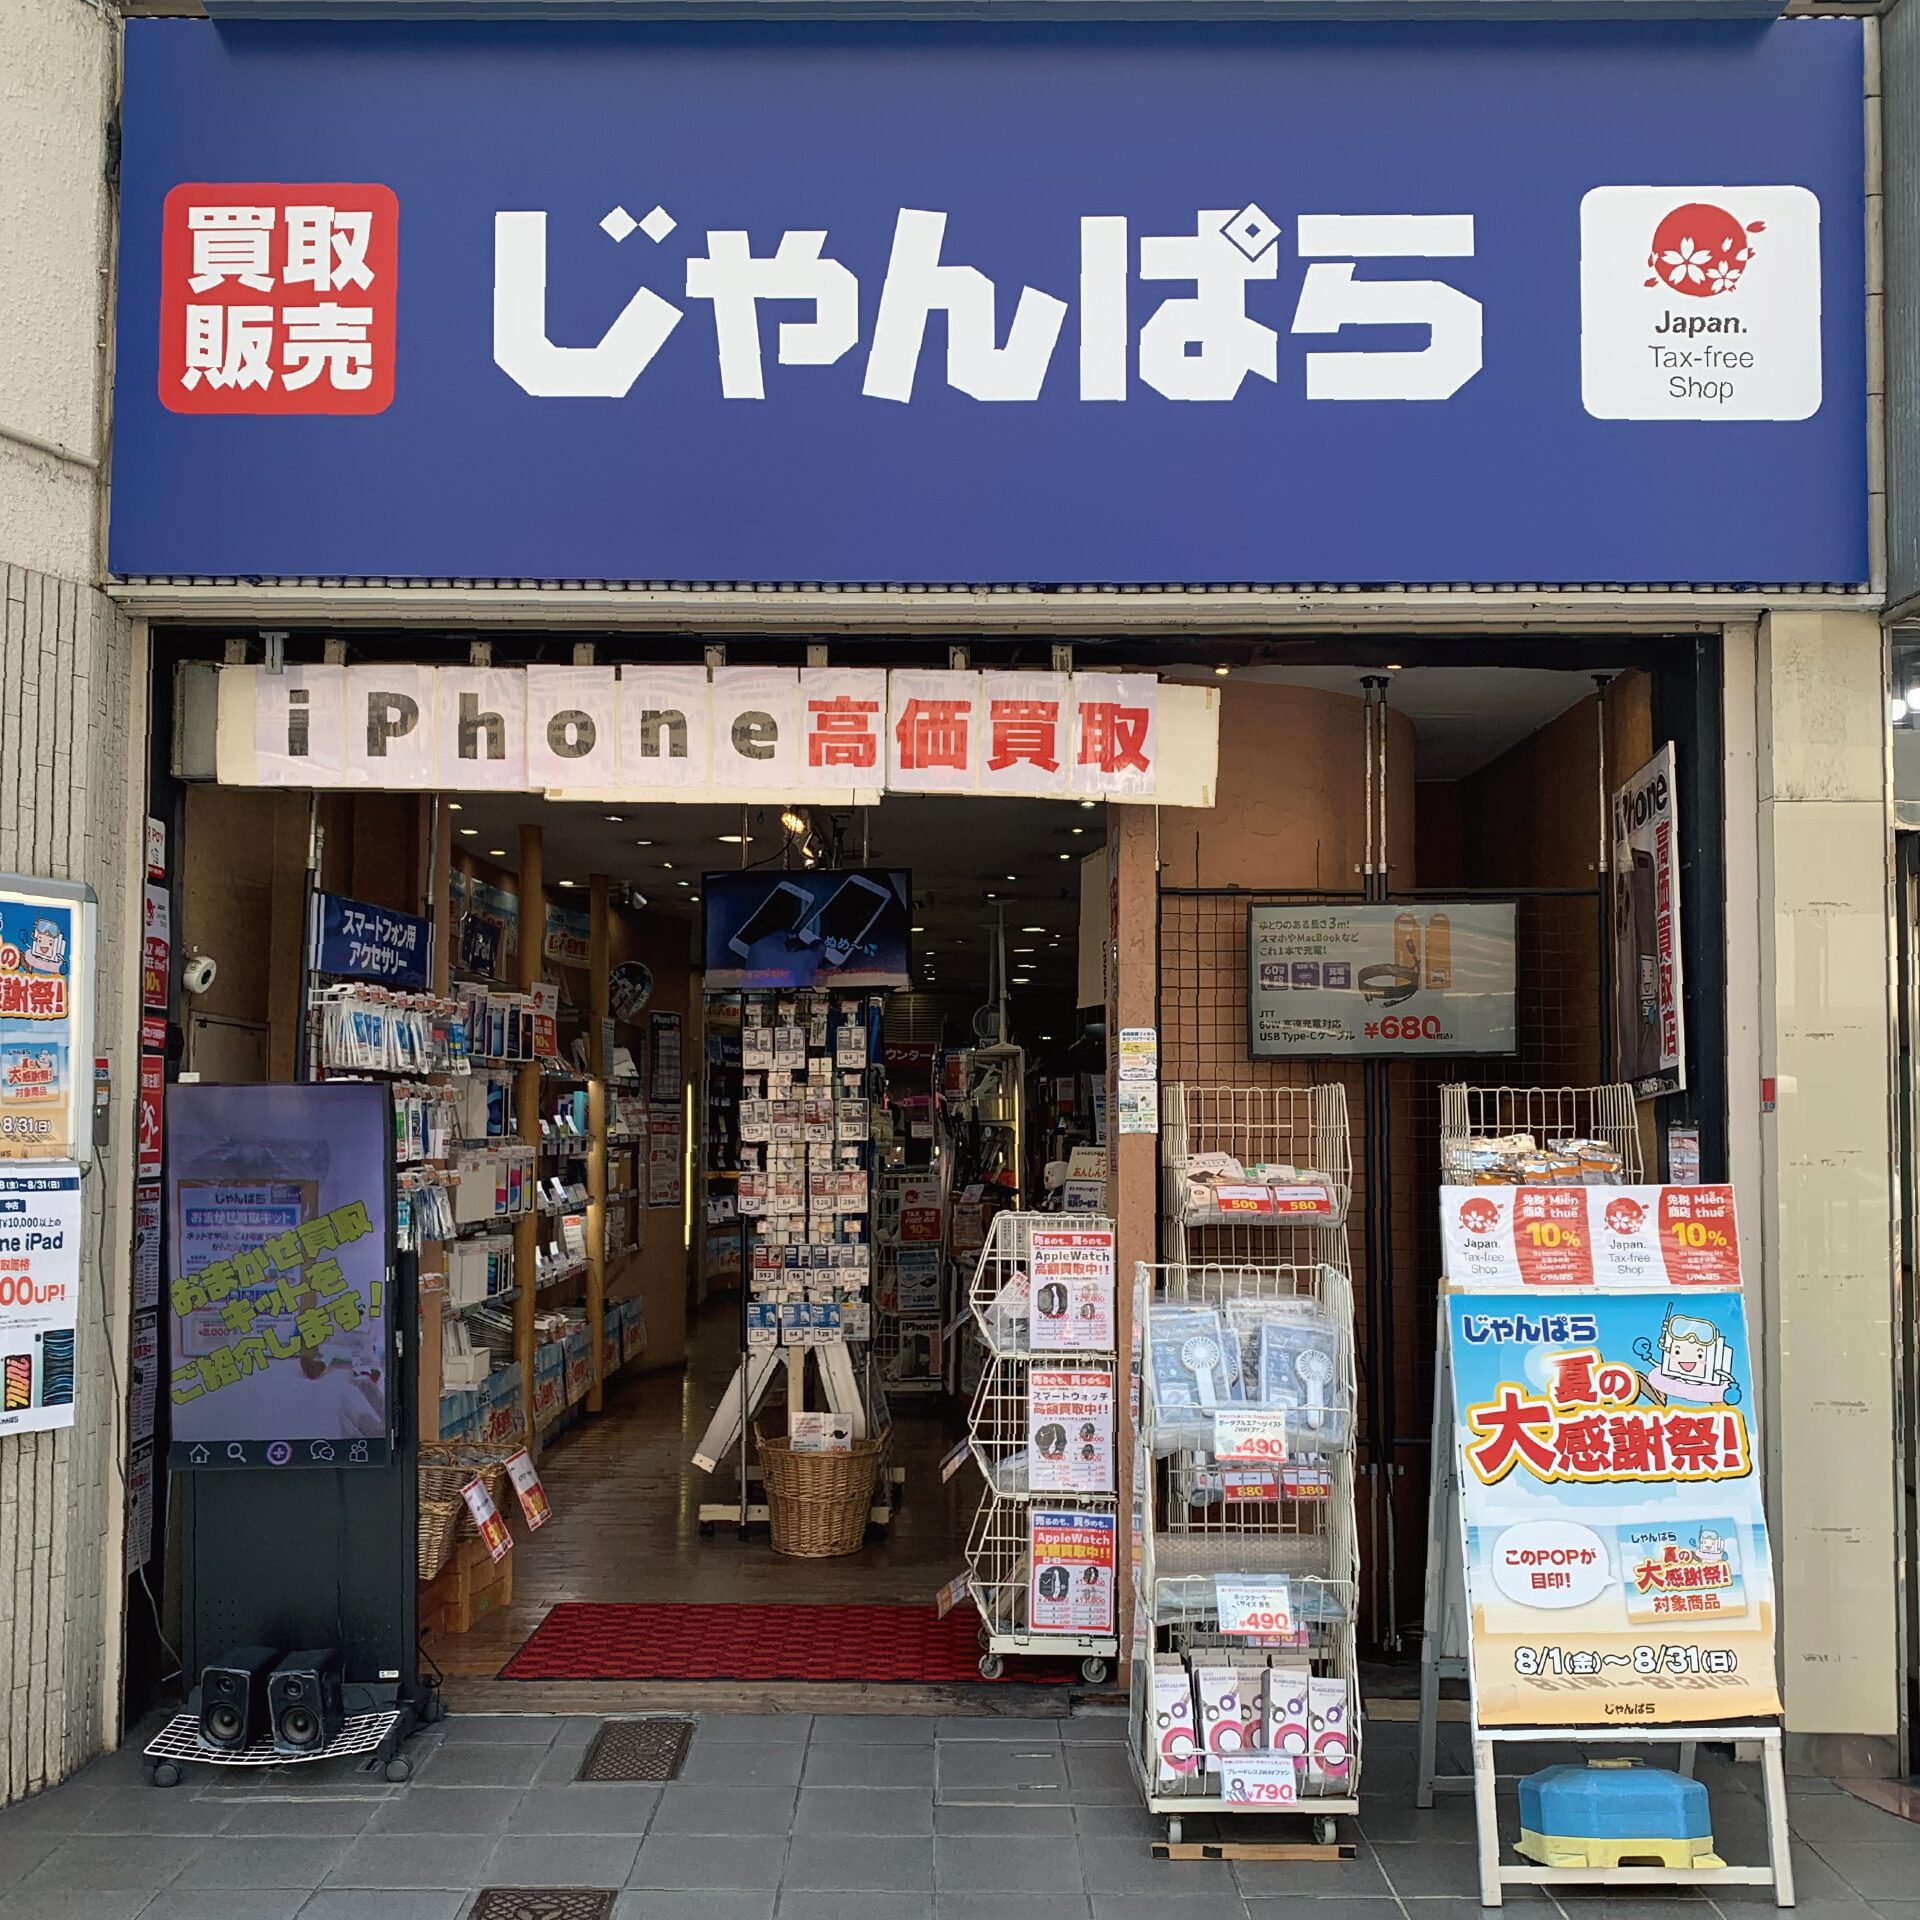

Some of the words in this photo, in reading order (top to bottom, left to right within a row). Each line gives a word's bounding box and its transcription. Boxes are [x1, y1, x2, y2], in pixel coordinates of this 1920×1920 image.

[187, 205, 376, 293] 買取
[492, 203, 1483, 403] じゃんぱら
[1654, 310, 1748, 339] Japan.
[180, 301, 374, 392] 販売
[1648, 344, 1755, 369] Tax-free
[1669, 375, 1734, 404] Shop
[342, 909, 416, 951] スマートフォン用
[1260, 932, 1360, 944] スマホやMacBookなど
[349, 941, 408, 975] アクセサリー
[1260, 945, 1327, 956] これ1本で充電!
[0, 976, 64, 1014] 謝祭!
[1259, 1010, 1275, 1018] JTT
[1260, 1032, 1281, 1041] USB
[1364, 1015, 1441, 1040] ¥680
[5, 1201, 20, 1211] 中古
[0, 1217, 61, 1229] ¥10,000以上の
[25, 1231, 63, 1251] iPad
[1464, 1238, 1501, 1250] Japan.
[1526, 1222, 1581, 1248] 10%
[1609, 1239, 1647, 1250] Japan.
[1671, 1222, 1728, 1248] 10%
[170, 1200, 374, 1319] おまかせ買取
[1035, 1251, 1110, 1262] AppleWatch
[1462, 1252, 1505, 1262] Tax-free
[1608, 1253, 1651, 1262] Tax-free
[1471, 1265, 1498, 1276] Shop
[1617, 1265, 1644, 1276] Shop
[219, 1258, 349, 1335] キットを
[902, 1322, 939, 1331] iPhone
[1463, 1314, 1596, 1345] じゃんぱら
[170, 1281, 383, 1405] ご紹介します!
[1554, 1354, 1631, 1403] 夏の
[1033, 1391, 1108, 1400] スマートウォッチ
[1472, 1392, 1745, 1477] 大感謝祭!
[1037, 1533, 1110, 1545] AppleWatch
[1505, 1548, 1597, 1566] このPOPが
[1531, 1572, 1571, 1589] 目印!
[1636, 1560, 1729, 1590] 大感謝祭!
[1653, 1593, 1721, 1613] 対象商品
[1604, 1703, 1655, 1715] じゃんぱら
